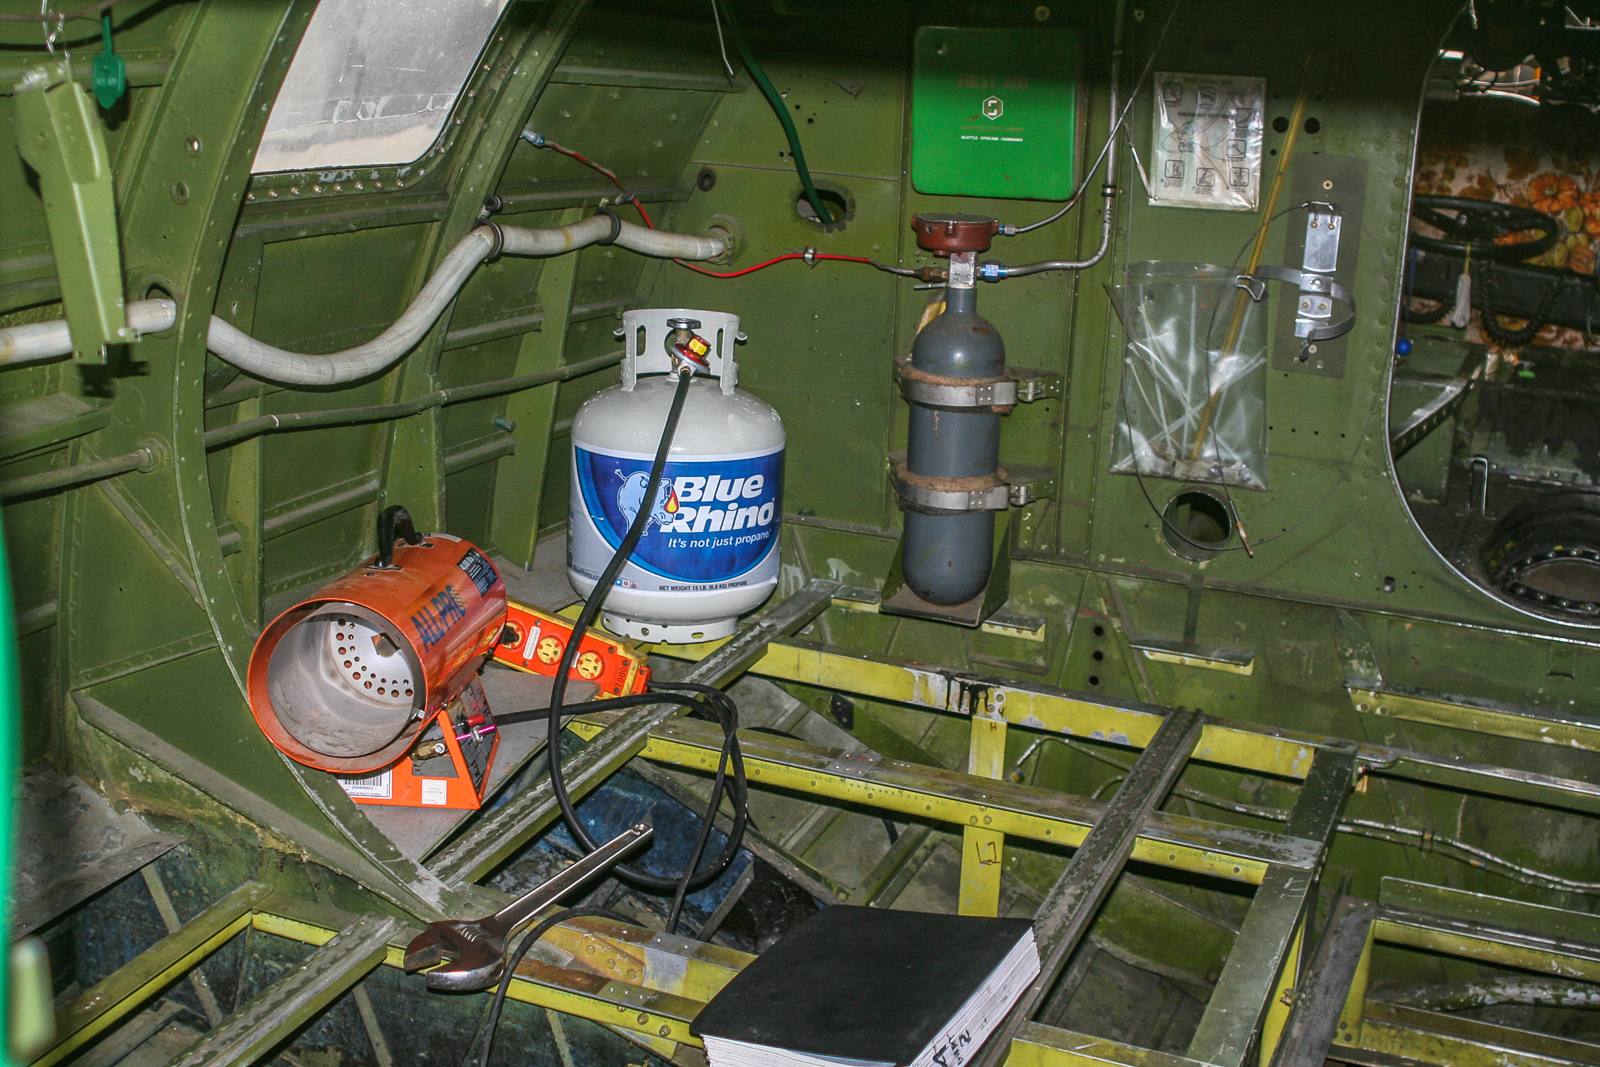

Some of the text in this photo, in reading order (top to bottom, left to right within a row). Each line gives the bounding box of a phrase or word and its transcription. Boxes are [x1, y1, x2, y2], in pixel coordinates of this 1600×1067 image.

[673, 474, 765, 502] Blue
[659, 502, 775, 533] Rhino
[668, 537, 687, 548] It's
[690, 538, 710, 548] not
[711, 536, 733, 549] just
[727, 580, 748, 588] PROPANE
